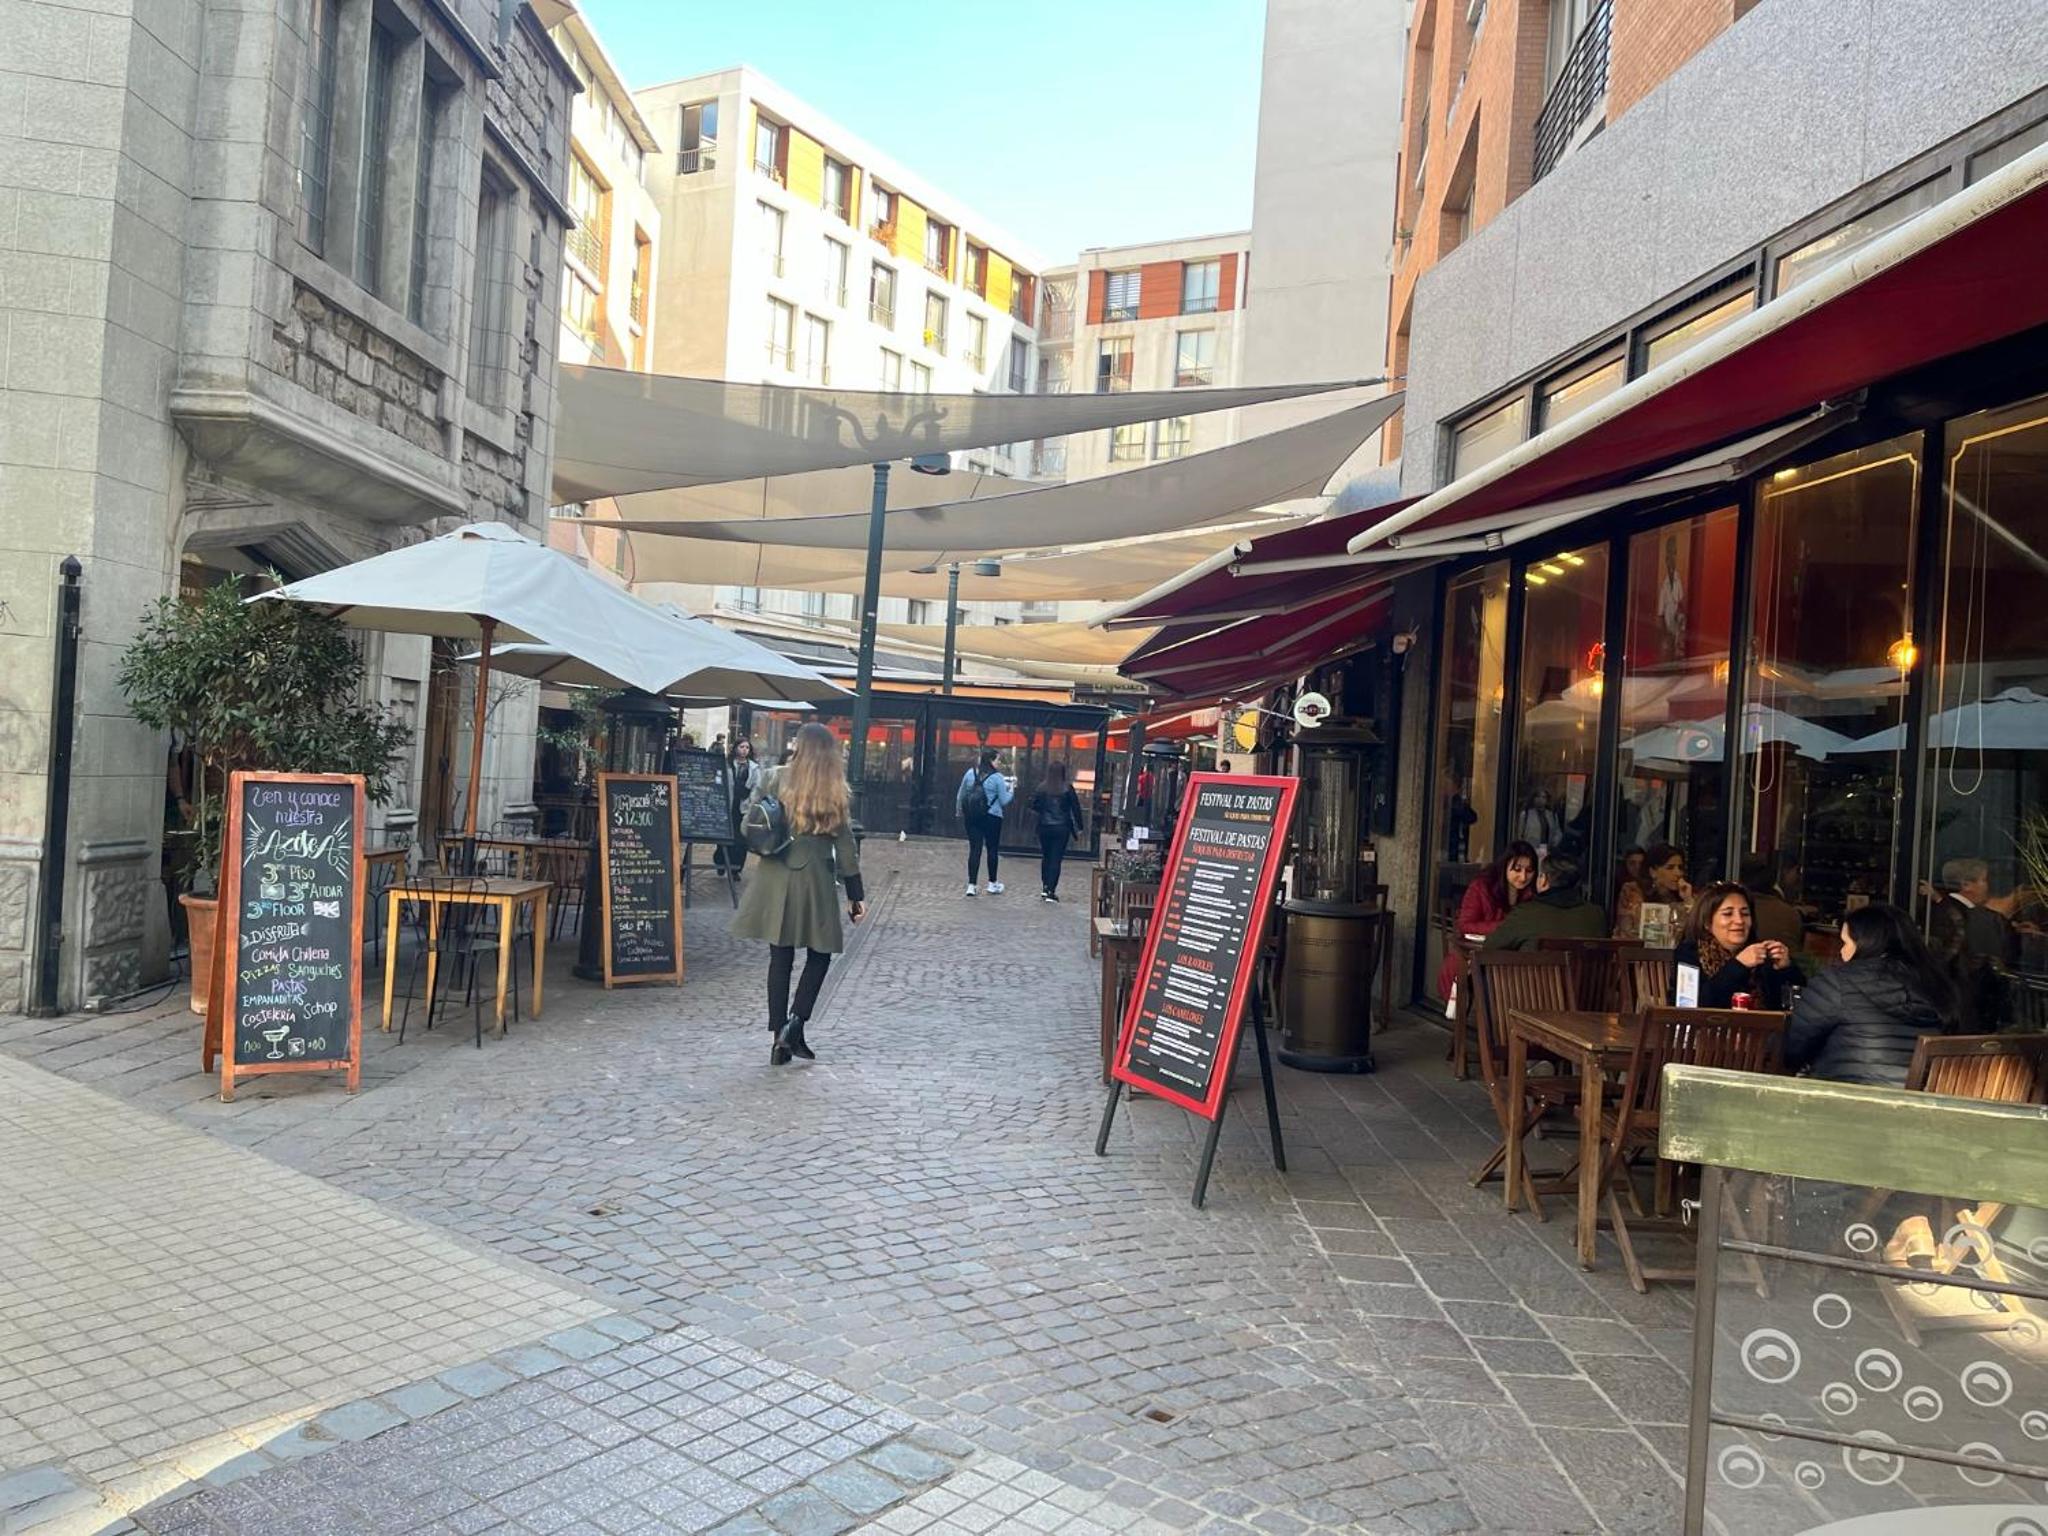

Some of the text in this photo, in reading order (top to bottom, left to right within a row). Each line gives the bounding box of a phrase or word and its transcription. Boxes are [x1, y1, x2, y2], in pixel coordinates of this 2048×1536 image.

[300, 791, 341, 807] conoce
[1200, 793, 1233, 807] FESTIVAL
[1234, 795, 1246, 808] DE
[275, 808, 324, 826] nuestra
[1189, 827, 1267, 850] FESTIVAL DE PASTAS
[292, 946, 330, 962] Chilena
[303, 1000, 338, 1020] Schop
